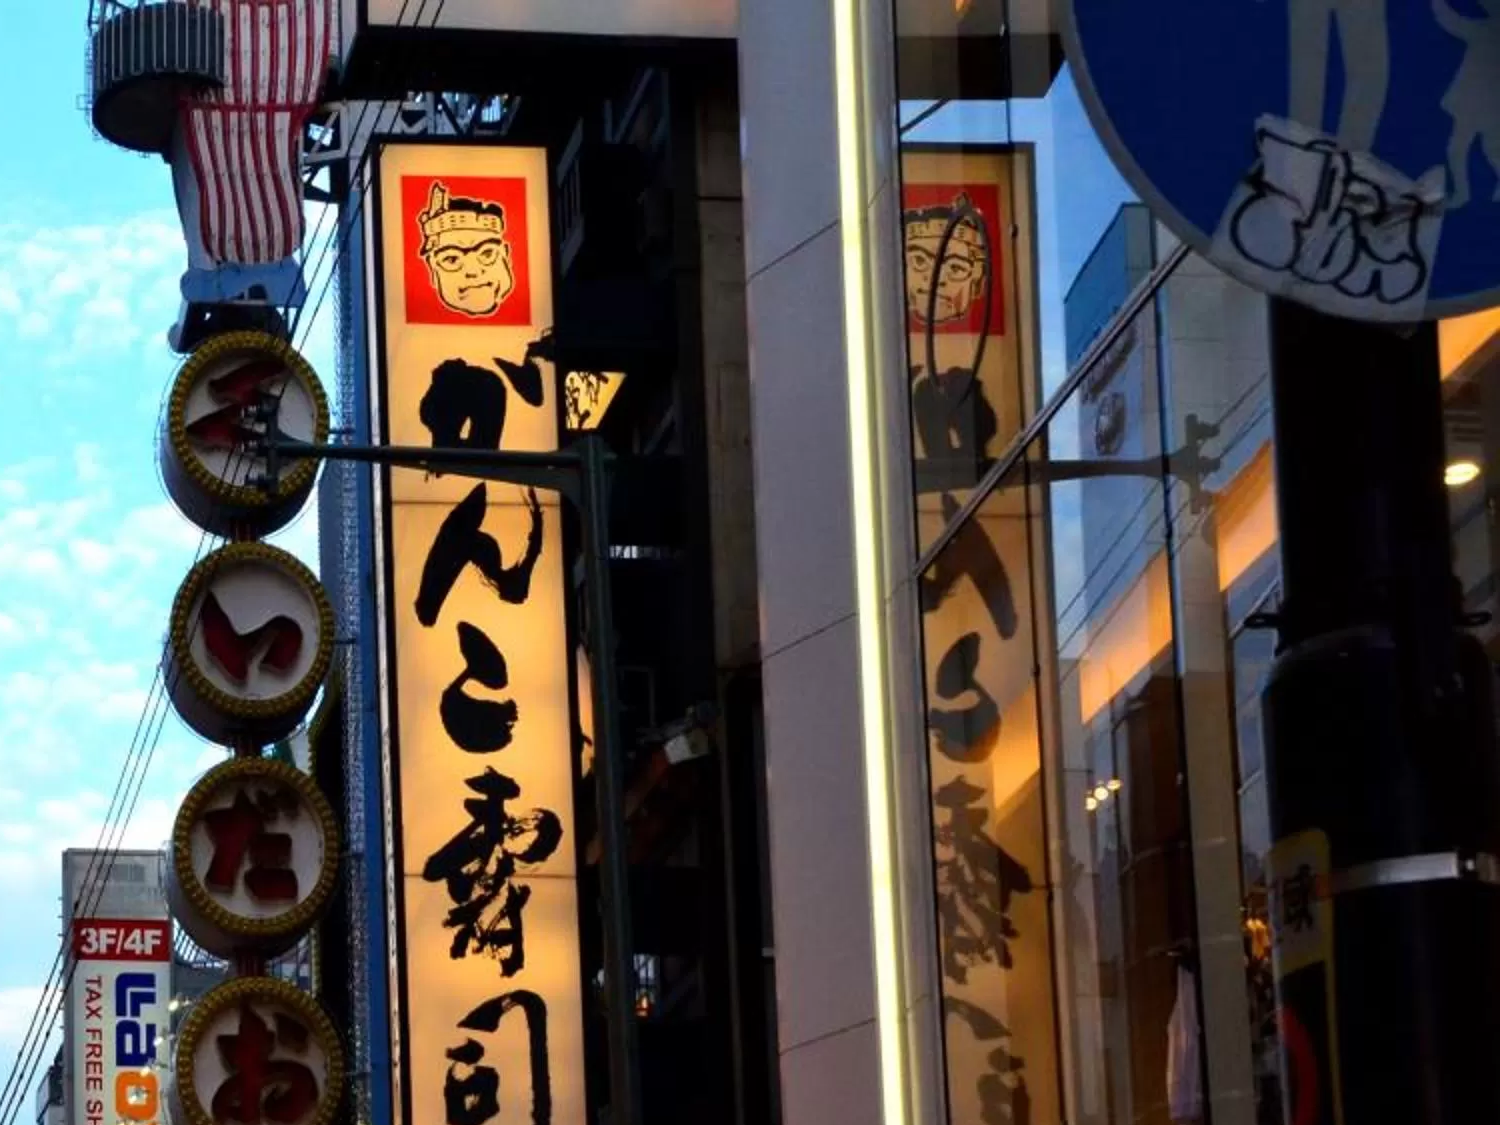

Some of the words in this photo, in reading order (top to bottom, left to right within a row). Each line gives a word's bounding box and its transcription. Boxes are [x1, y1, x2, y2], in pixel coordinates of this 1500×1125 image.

[80, 927, 163, 956] 3F/4F
[84, 975, 102, 1020] TAX
[85, 1027, 103, 1092] FREE
